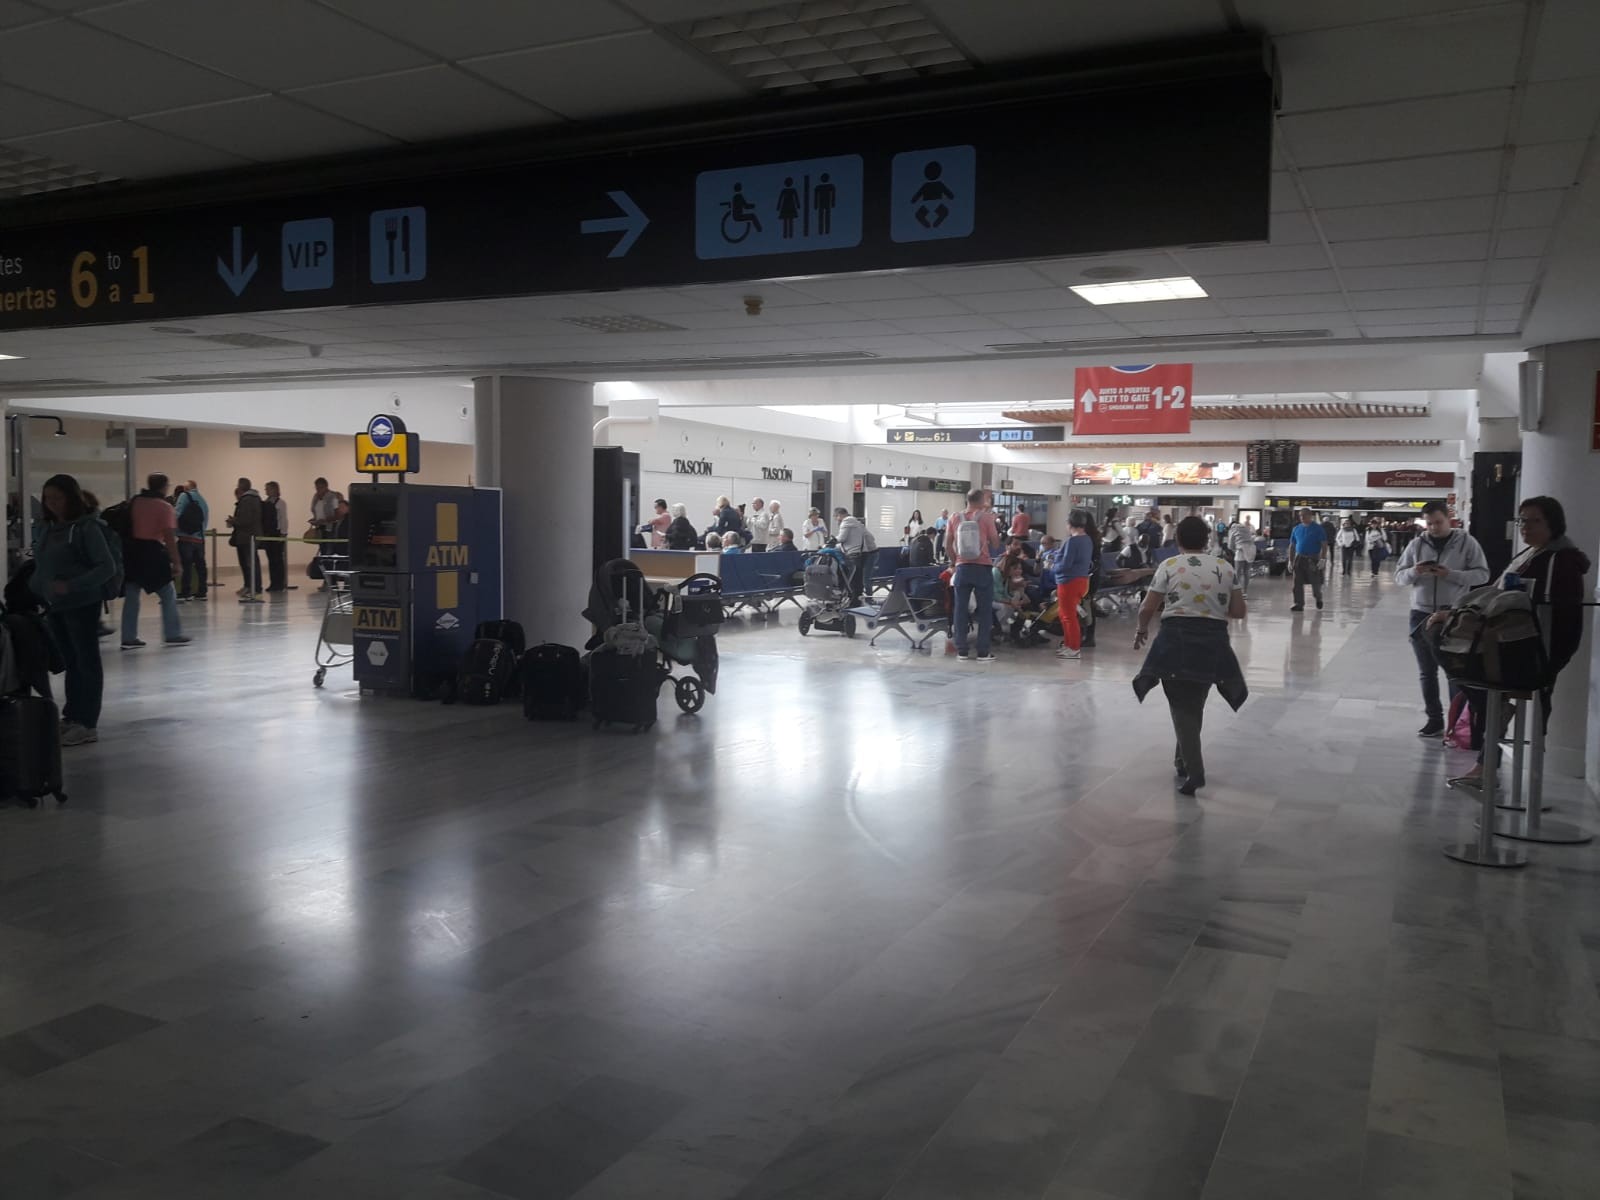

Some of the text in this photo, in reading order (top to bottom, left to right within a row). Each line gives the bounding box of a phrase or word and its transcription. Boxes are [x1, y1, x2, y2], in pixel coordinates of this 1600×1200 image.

[288, 241, 327, 268] VIP
[71, 251, 98, 308] 6
[107, 252, 121, 270] to
[132, 246, 155, 304] 1
[109, 283, 120, 303] a
[1099, 395, 1117, 403] NEXT
[1131, 394, 1150, 402] GATE
[1151, 386, 1185, 409] 1-2
[934, 432, 940, 441] 6
[365, 453, 399, 467] ATM
[674, 457, 713, 477] TASCÓN
[762, 465, 793, 482] TASCÓN
[426, 545, 469, 567] ATM
[357, 609, 397, 628] ATM
